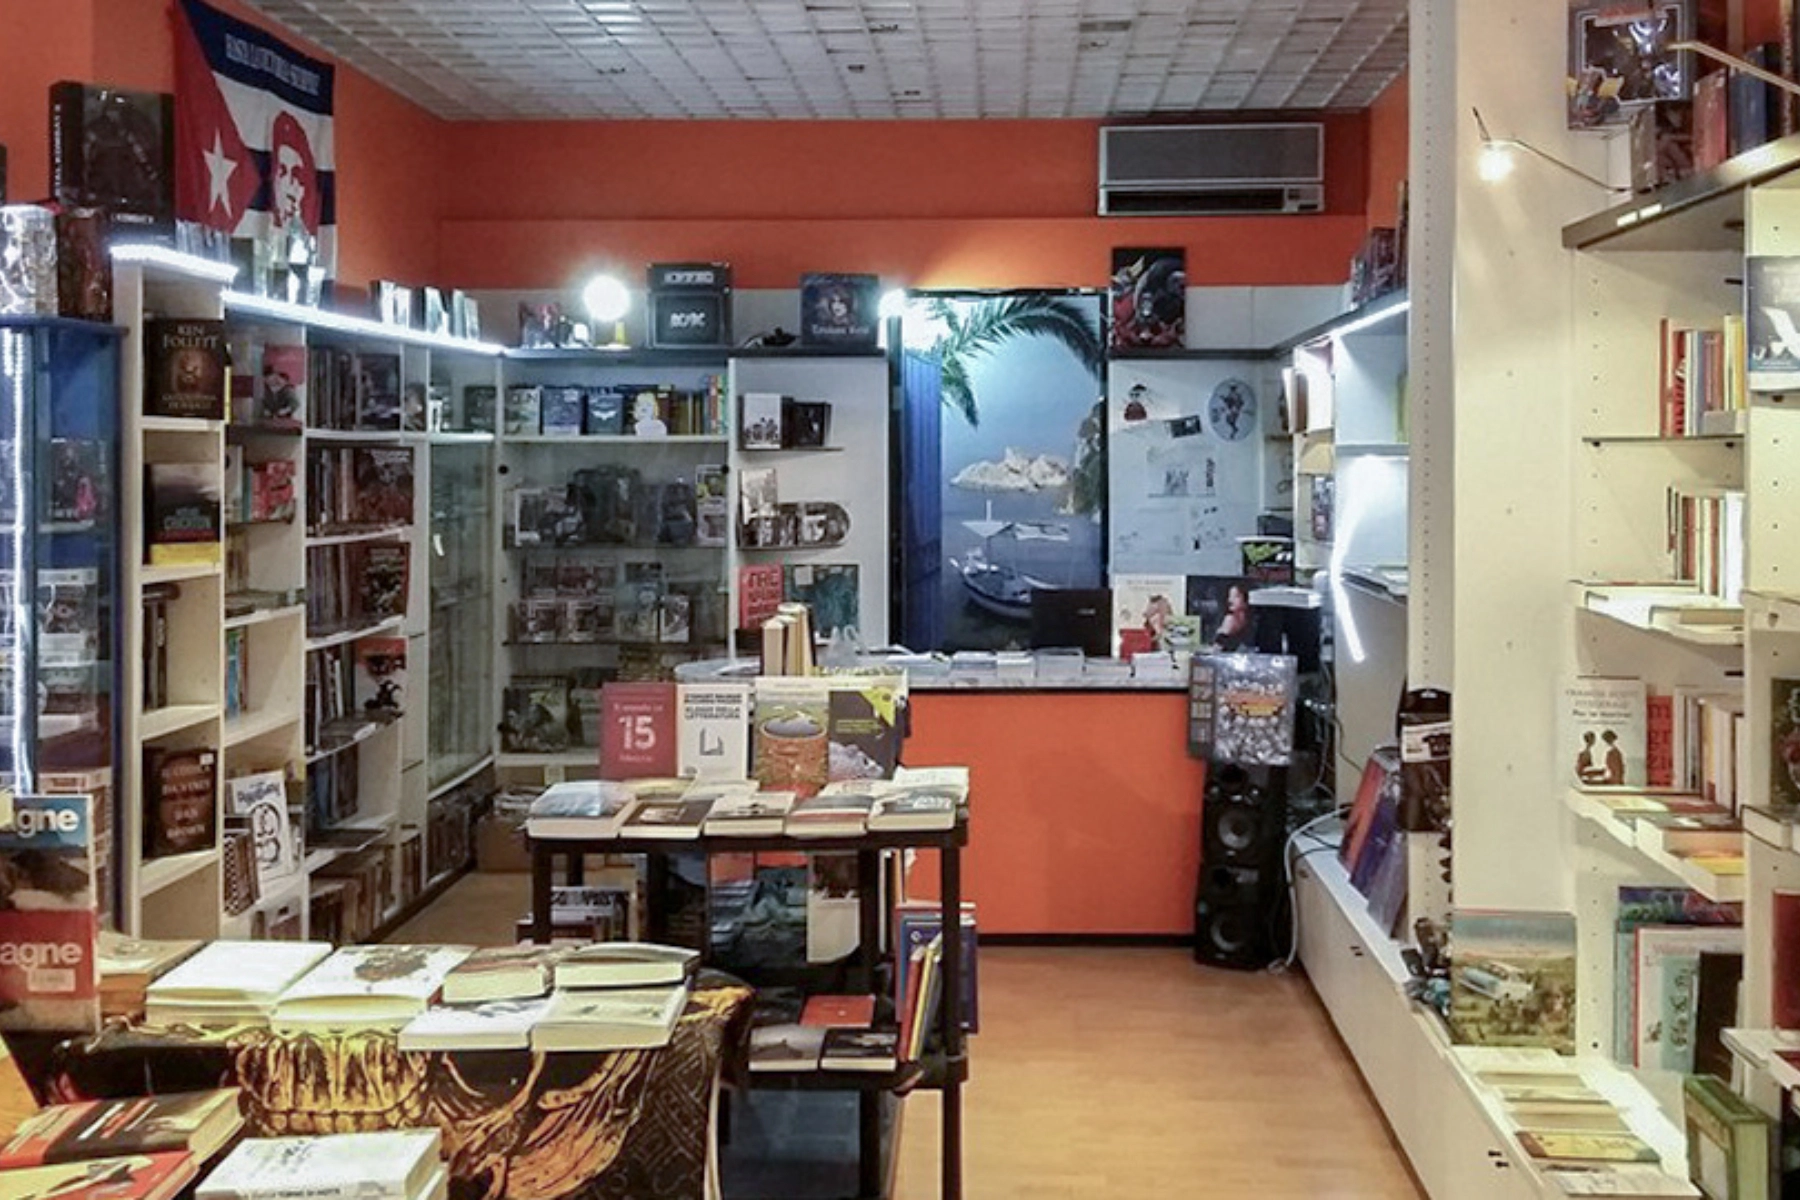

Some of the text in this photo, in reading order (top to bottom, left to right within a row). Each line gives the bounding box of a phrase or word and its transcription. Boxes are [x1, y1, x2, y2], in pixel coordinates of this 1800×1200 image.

[177, 325, 204, 335] KEN
[163, 334, 217, 348] FOLLETT
[618, 714, 656, 750] 15
